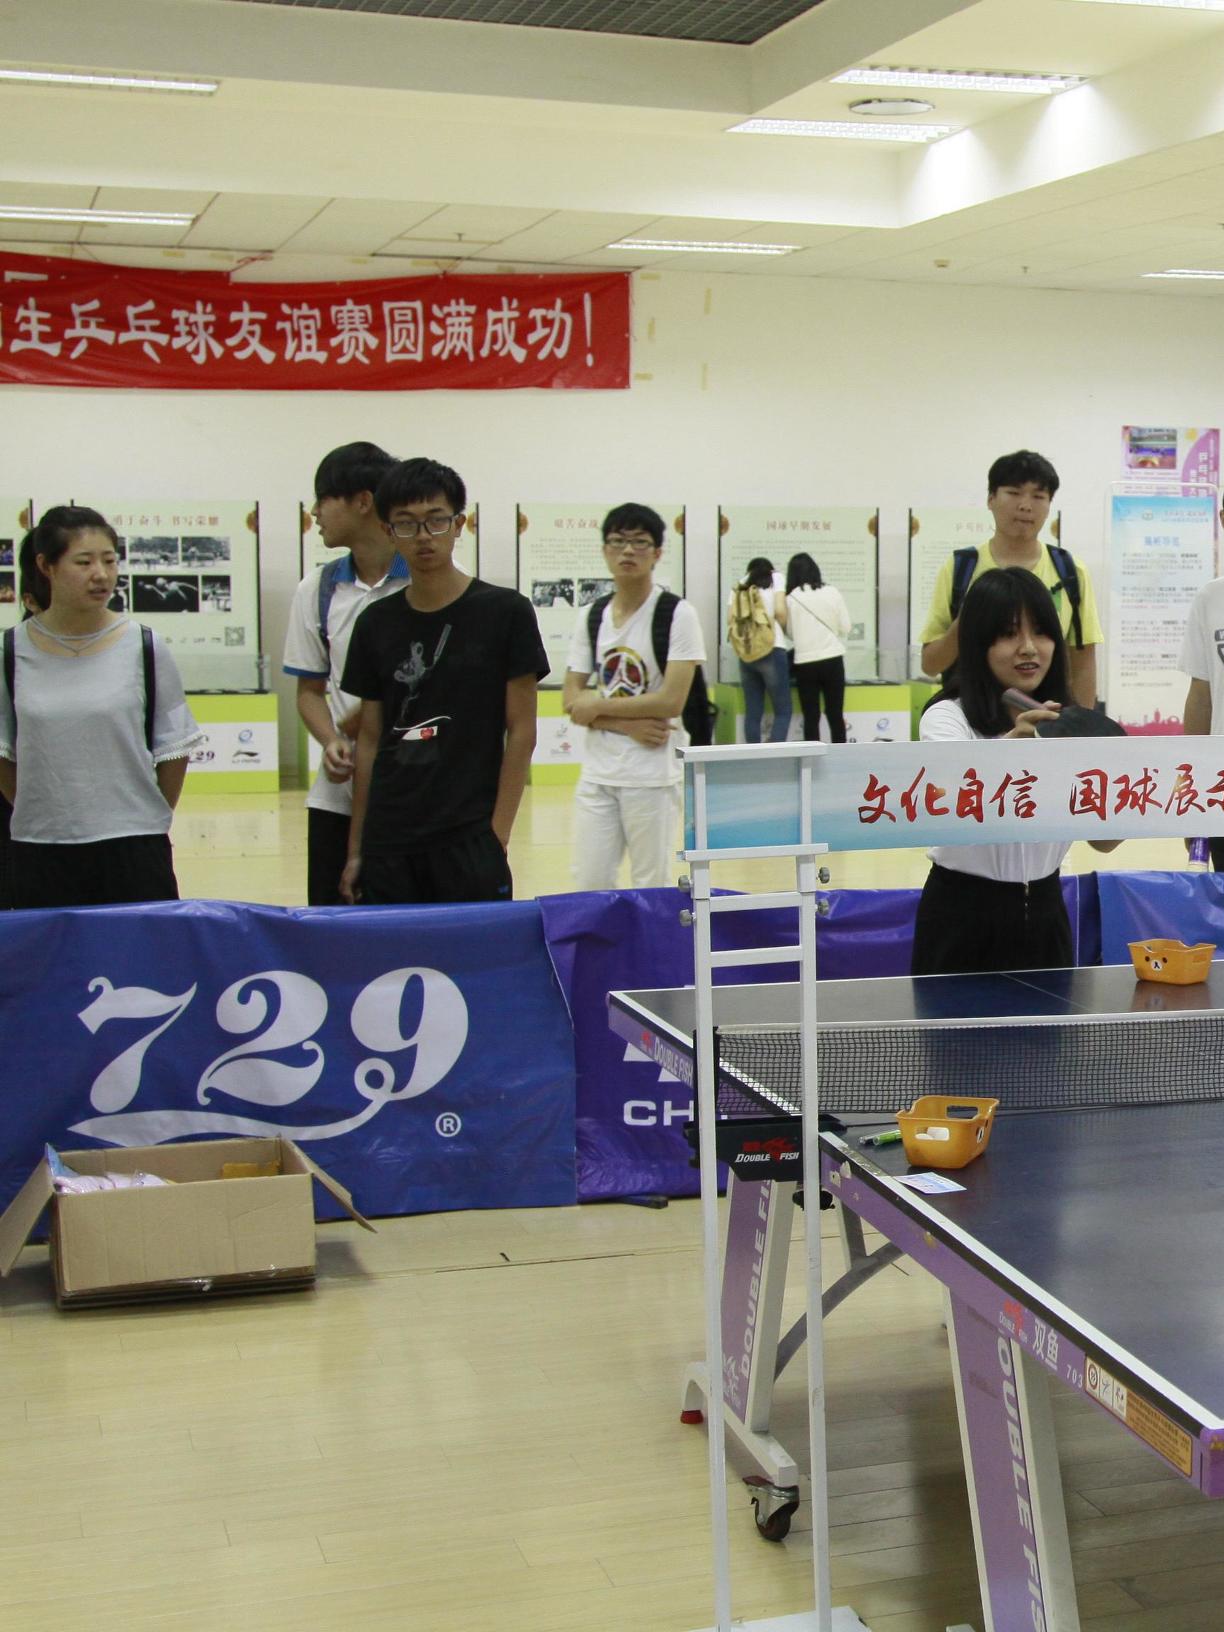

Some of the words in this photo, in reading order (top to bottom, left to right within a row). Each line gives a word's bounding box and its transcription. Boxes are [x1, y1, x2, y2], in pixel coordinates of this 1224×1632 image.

[0, 293, 594, 367] 生乒乓球友谊赛圆满成功!
[857, 766, 1039, 825] 文化自信
[77, 966, 469, 1114] 729
[654, 1037, 679, 1075] DOUBLE
[735, 1153, 771, 1163] DOUBLE
[779, 1151, 800, 1161] FISH
[740, 1231, 766, 1380] DOUBLE
[758, 1179, 772, 1221] FI
[1032, 1318, 1059, 1371] 双鱼
[1066, 1364, 1083, 1389] 703
[997, 1332, 1033, 1535] OUBLE
[1022, 1545, 1047, 1632] FIS
